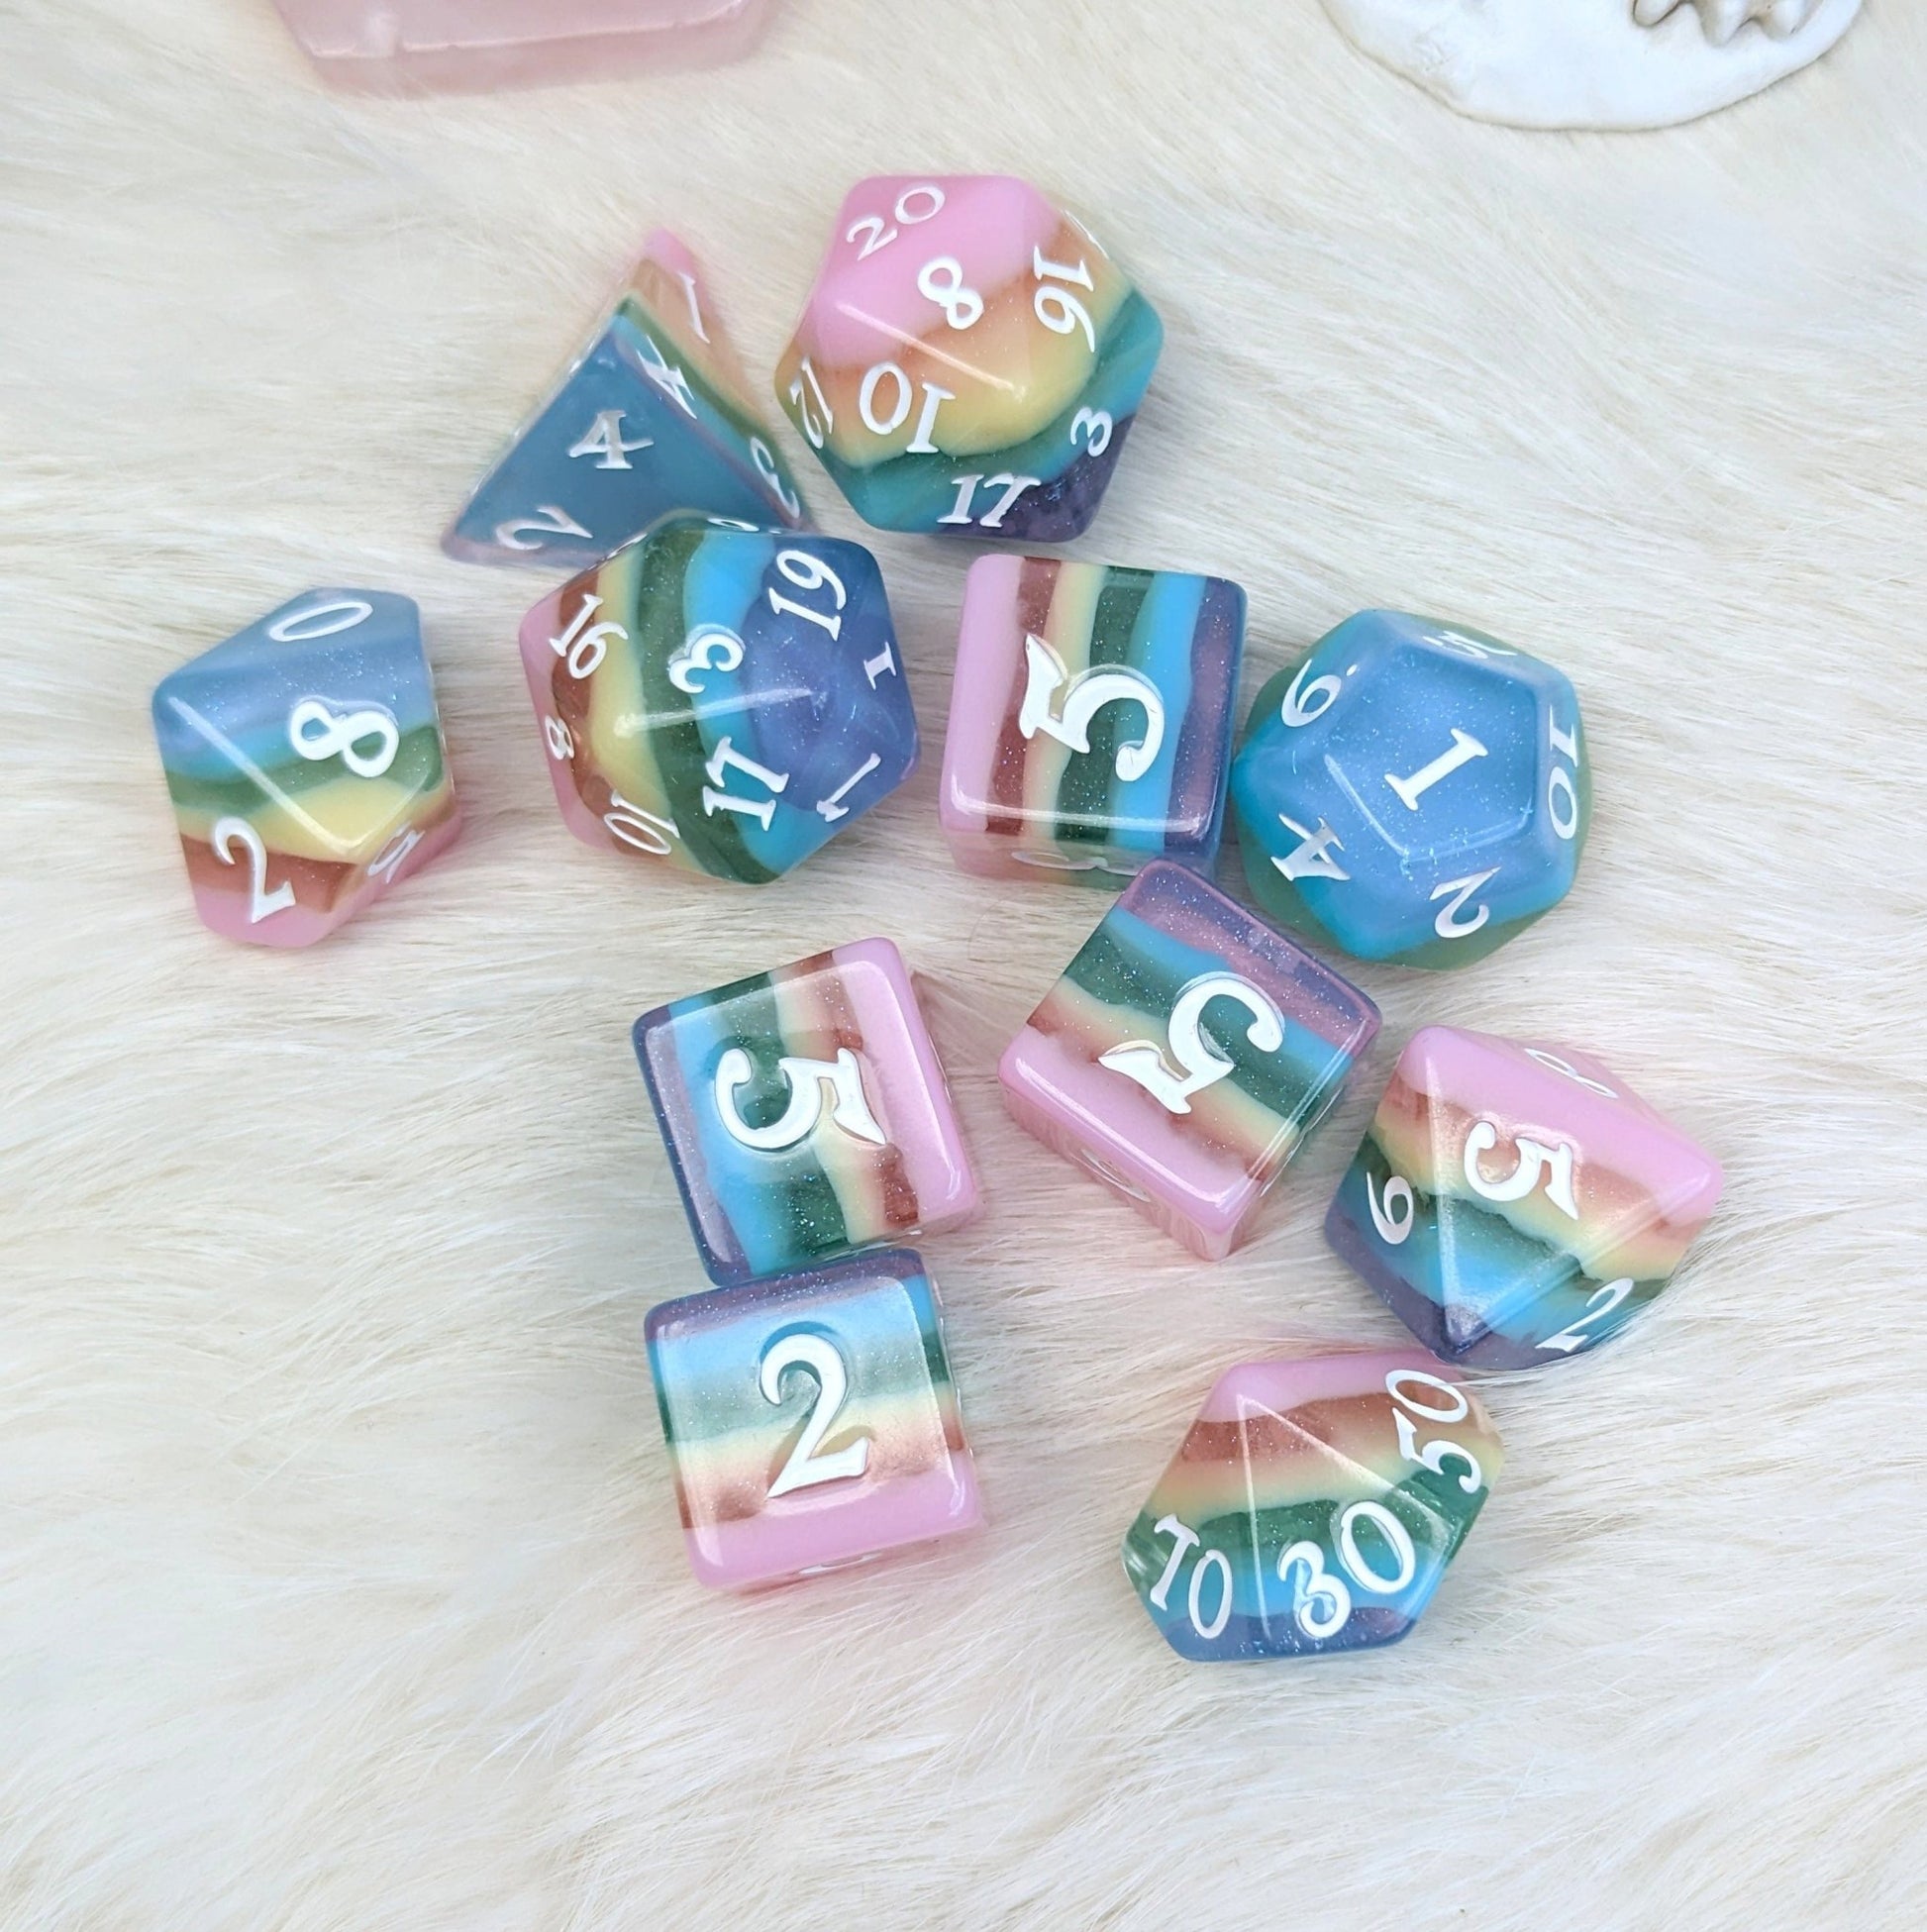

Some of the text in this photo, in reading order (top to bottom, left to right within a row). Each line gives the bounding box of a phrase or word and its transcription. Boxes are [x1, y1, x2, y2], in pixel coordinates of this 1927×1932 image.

[846, 185, 946, 260] 20
[677, 271, 710, 345] 1
[917, 256, 984, 330] 8
[1033, 246, 1095, 353] 16
[566, 409, 654, 469] 4
[859, 362, 956, 454] 10
[1069, 407, 1113, 457] 3
[495, 504, 594, 551] 2
[937, 472, 1042, 529] 17
[268, 602, 373, 642] 0
[768, 549, 847, 642] 19
[549, 594, 629, 679] 16
[668, 624, 745, 694] 3
[863, 641, 898, 690] 1
[289, 698, 399, 778] 8
[546, 715, 574, 761] 8
[1019, 634, 1166, 781] 5
[702, 736, 789, 832] 17
[1383, 728, 1489, 811] 1
[1548, 704, 1577, 840] 10
[604, 789, 680, 856] 10
[1269, 812, 1352, 881] 4
[213, 817, 295, 924] 2
[1429, 866, 1502, 938] 2
[1098, 976, 1284, 1114] 5
[1524, 1048, 1619, 1098] 8
[715, 1048, 887, 1150] 5
[1464, 1120, 1579, 1220] 5
[1367, 1171, 1414, 1246] 6
[1535, 1277, 1635, 1353] 2
[760, 1332, 870, 1498] 2
[1385, 1370, 1482, 1493] 50
[1278, 1500, 1416, 1639] 30
